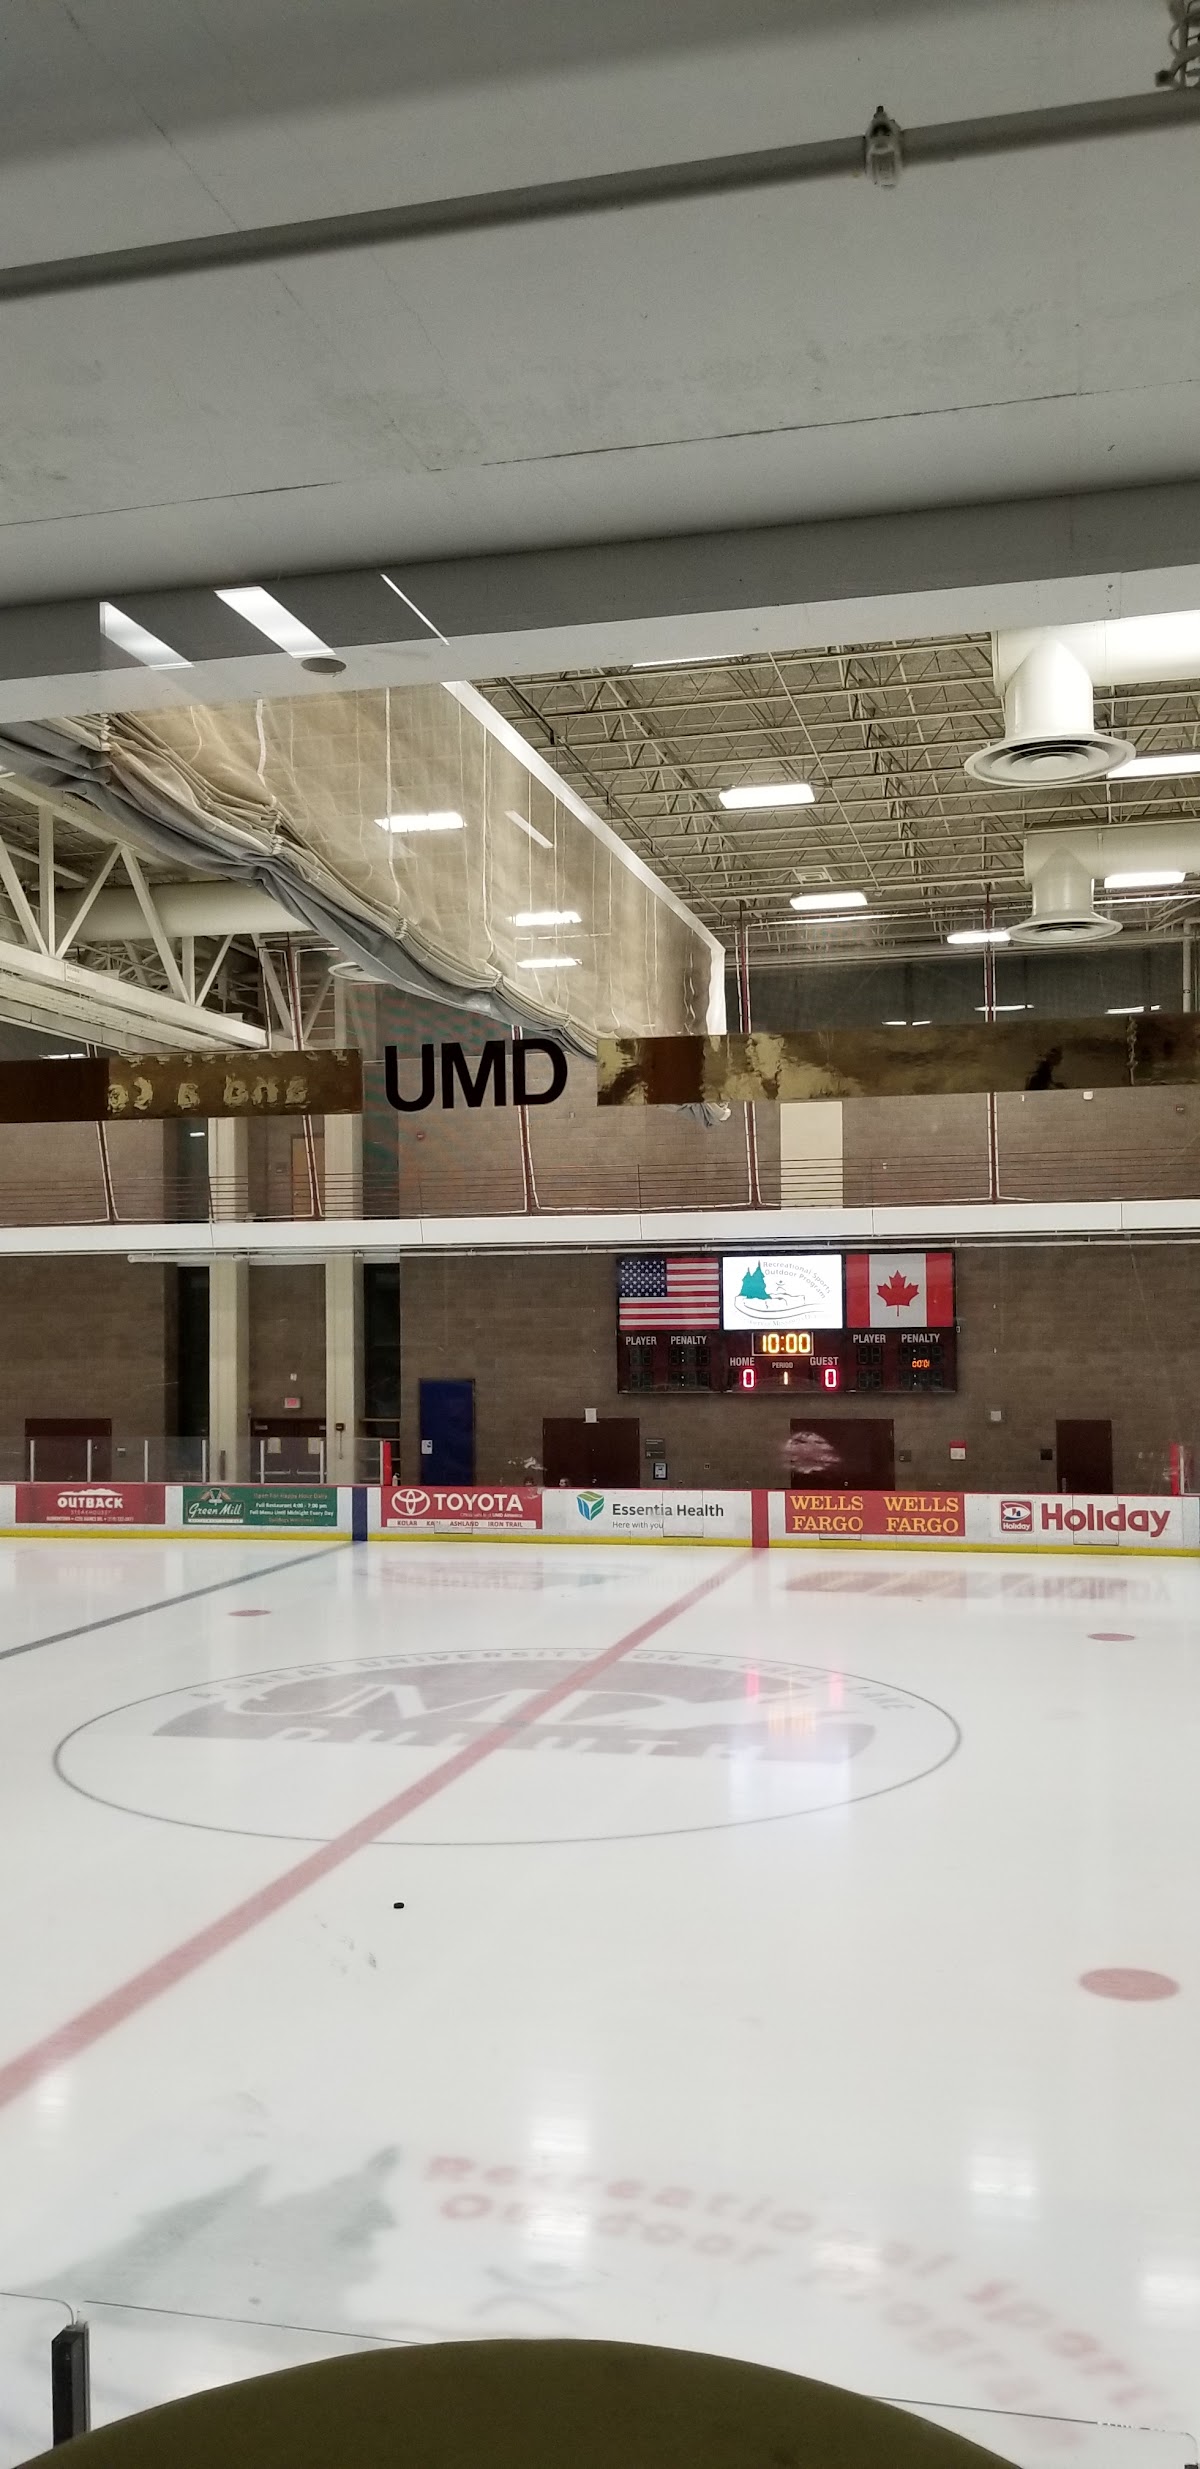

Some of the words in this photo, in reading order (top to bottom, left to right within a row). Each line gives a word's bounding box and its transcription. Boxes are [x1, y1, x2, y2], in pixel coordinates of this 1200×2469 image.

[385, 1038, 568, 1112] UMD
[763, 1261, 812, 1275] Recreational
[813, 1272, 831, 1294] Sports
[764, 1269, 797, 1277] Outdoor
[799, 1273, 826, 1299] Program
[625, 1336, 657, 1345] PLAYER
[670, 1335, 707, 1345] PENALTY
[762, 1333, 811, 1353] 10:00
[853, 1334, 886, 1343] PLAYER
[901, 1333, 940, 1343] PENALTY
[729, 1357, 755, 1366] HOME
[810, 1356, 839, 1366] GUEST
[742, 1368, 755, 1387] 0
[783, 1371, 788, 1385] 1
[825, 1368, 837, 1387] 0
[57, 1497, 123, 1509] OUTBACK
[433, 1493, 524, 1511] TOYOTA
[612, 1503, 672, 1516] Essentia
[677, 1504, 724, 1517] Health
[790, 1495, 863, 1511] WELLS
[883, 1496, 959, 1512] WELLS
[189, 1503, 218, 1518] Green
[219, 1503, 242, 1515] Mill
[612, 1521, 631, 1529] Here
[632, 1521, 648, 1529] with
[650, 1522, 664, 1530] you
[792, 1515, 863, 1532] FARGO
[886, 1517, 959, 1533] FARGO
[1003, 1522, 1031, 1531] Holiday
[1041, 1503, 1171, 1538] Holiday
[632, 1653, 687, 1662] ON
[438, 2191, 782, 2268] Oudoor
